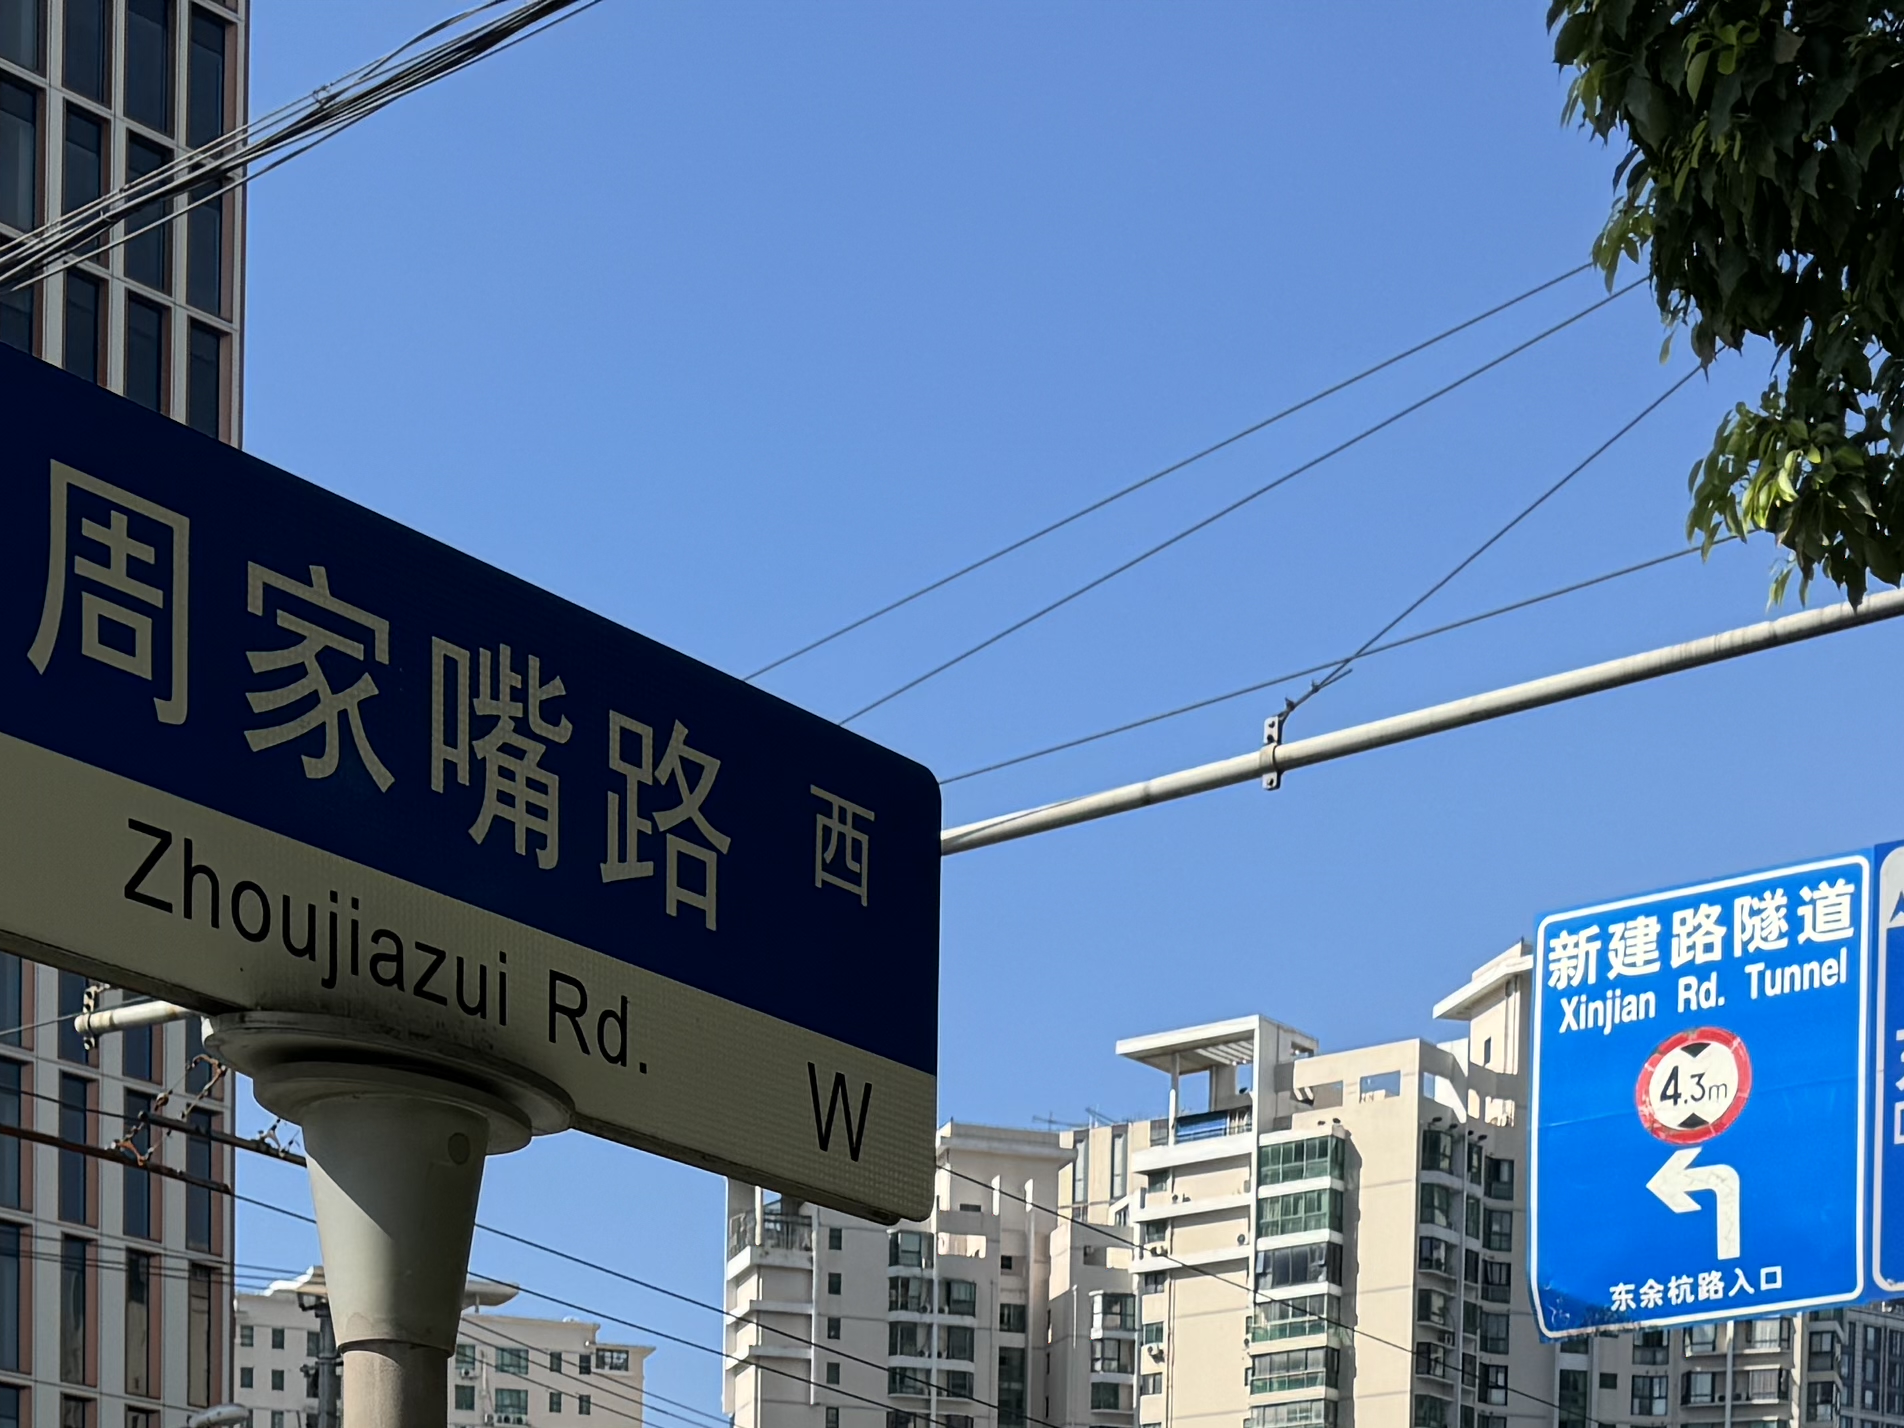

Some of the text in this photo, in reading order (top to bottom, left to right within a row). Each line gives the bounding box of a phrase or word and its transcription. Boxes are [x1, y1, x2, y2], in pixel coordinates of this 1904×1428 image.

[27, 457, 732, 932] 周家嘴路
[810, 783, 876, 907] 西
[125, 818, 649, 1074] Zhoujiazui Rd.
[1548, 878, 1855, 991] 新建路隧道
[1559, 950, 1847, 1035] Xinjian Rd. Tunnel
[807, 1061, 873, 1165] W
[1659, 1064, 1728, 1106] 4.3m
[1610, 1263, 1783, 1312] 东余杭路入口
